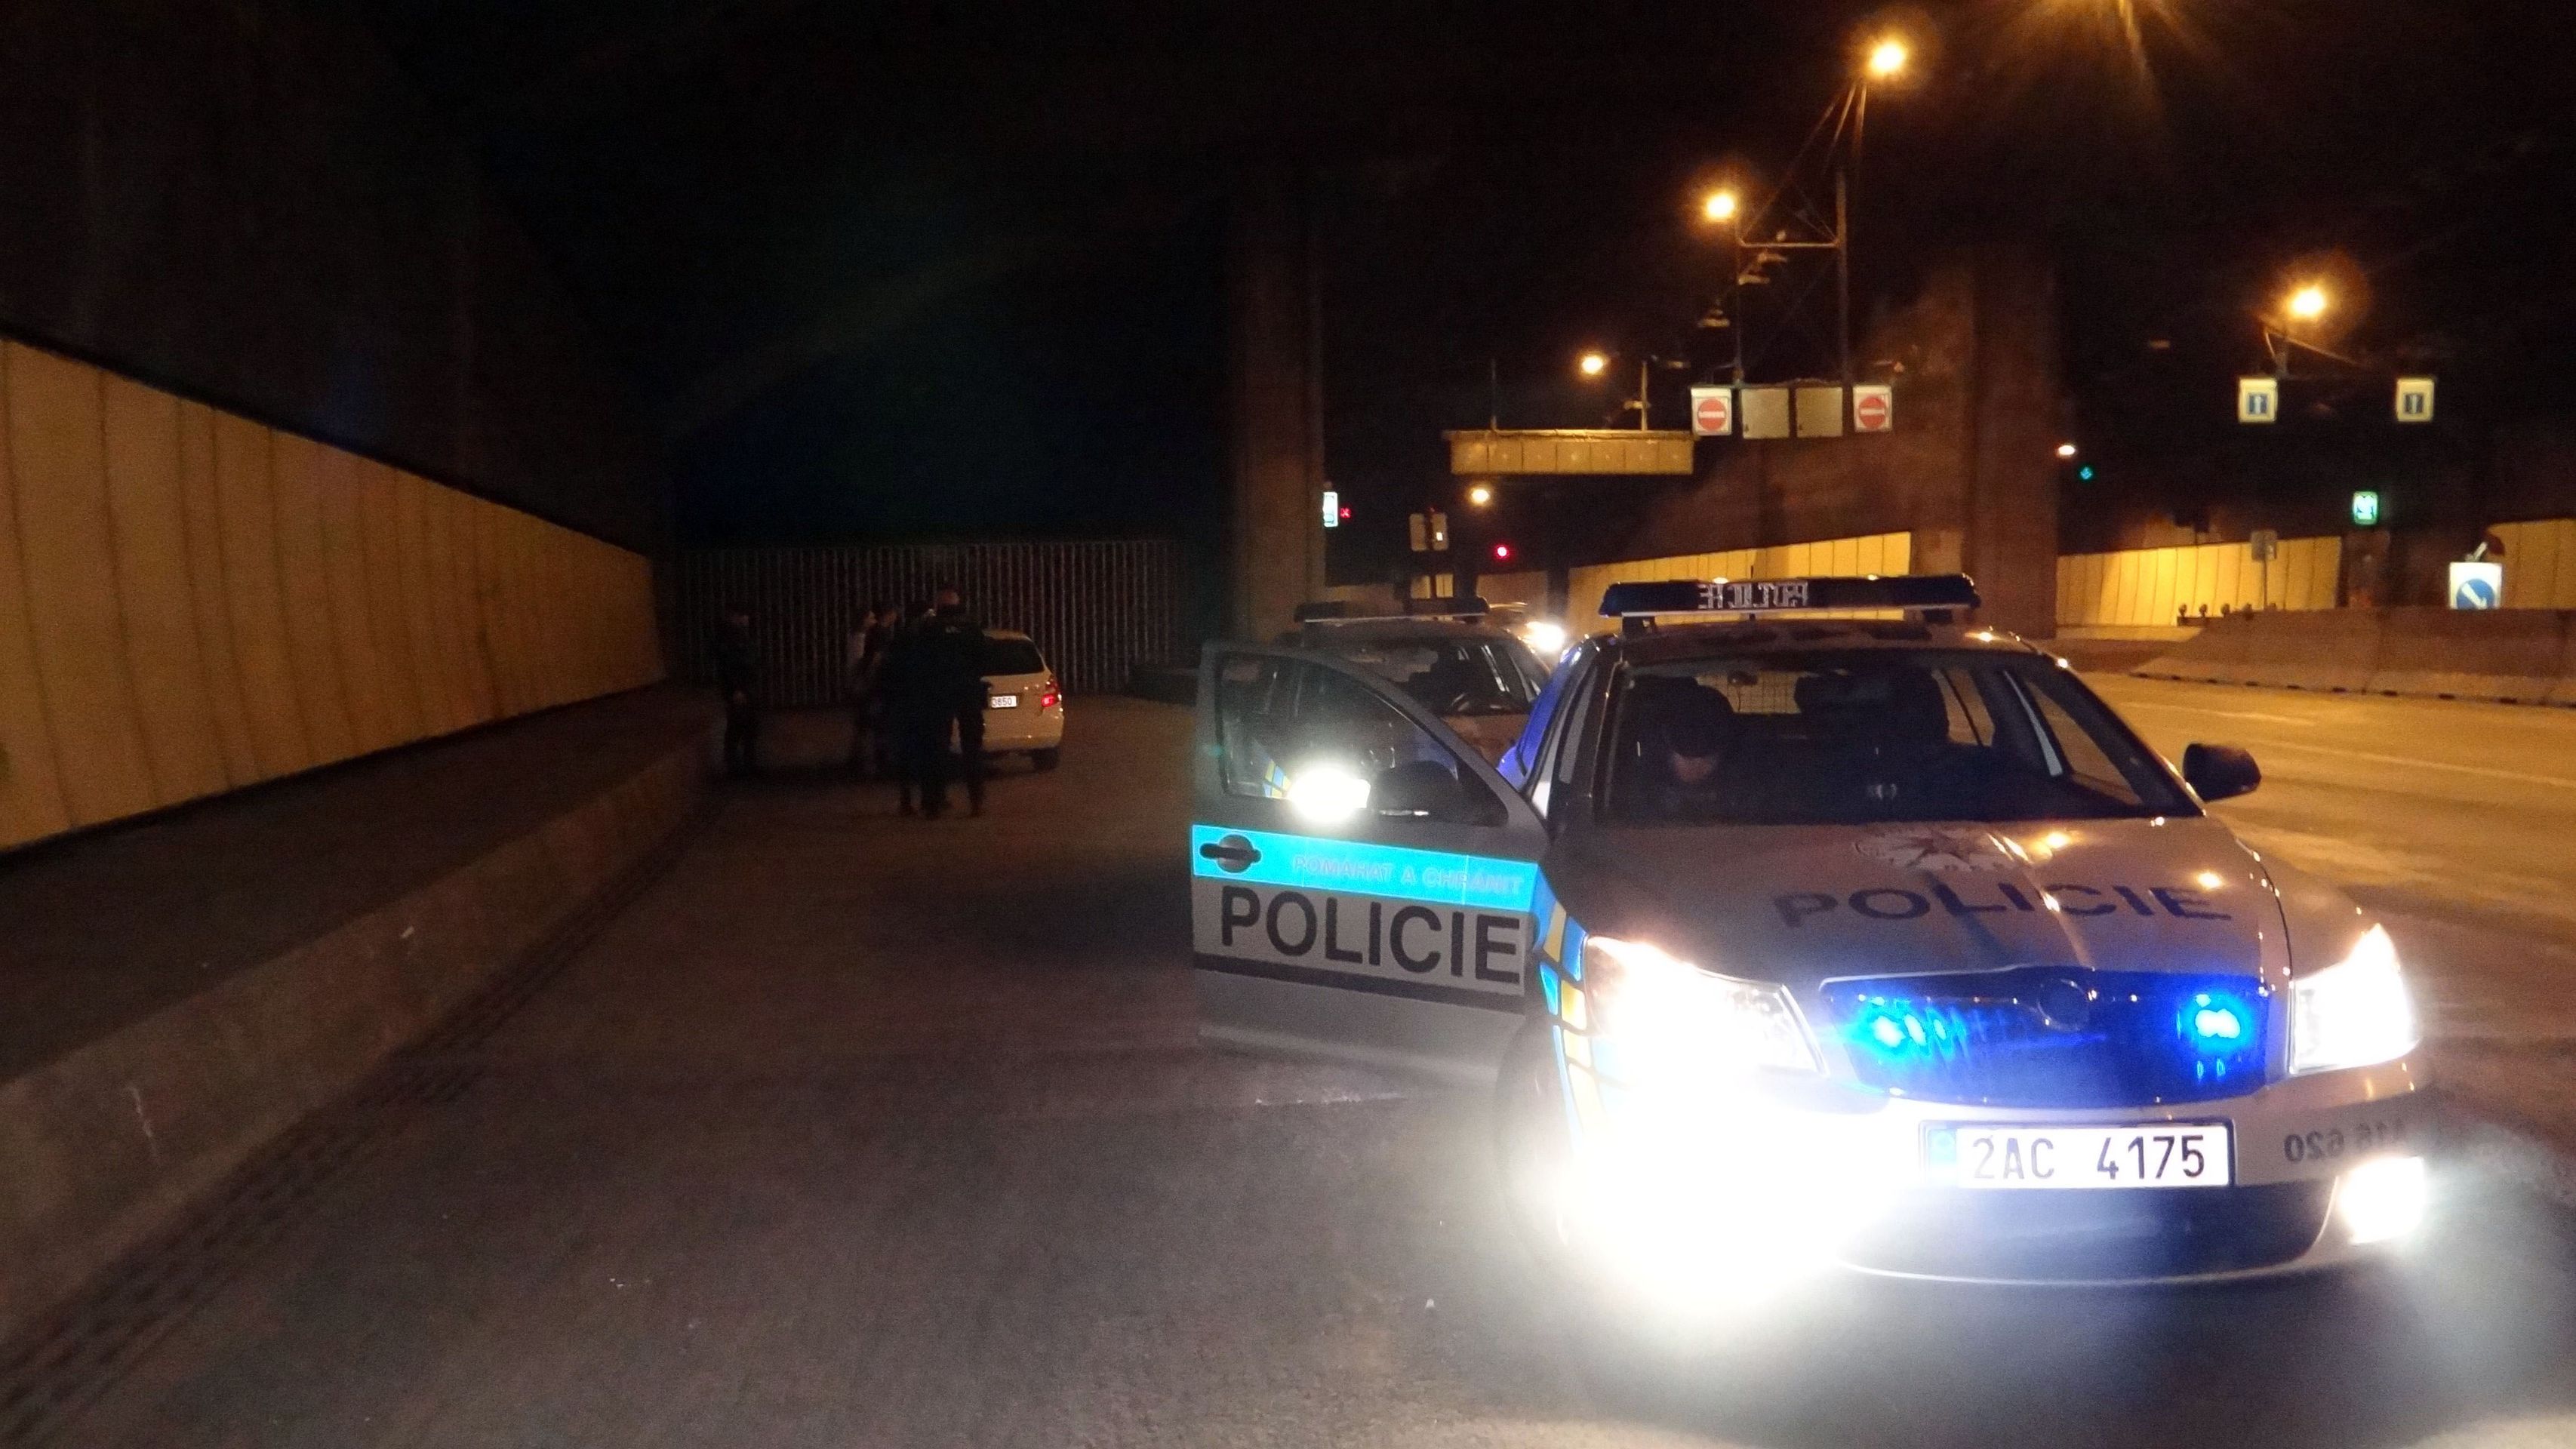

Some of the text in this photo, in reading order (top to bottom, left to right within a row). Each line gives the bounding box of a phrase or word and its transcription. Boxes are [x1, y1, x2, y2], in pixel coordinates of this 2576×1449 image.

[1774, 881, 2232, 928] POLICIE
[1220, 884, 1521, 984] POLICIE
[1971, 1134, 2205, 1180] 2AC 4175
